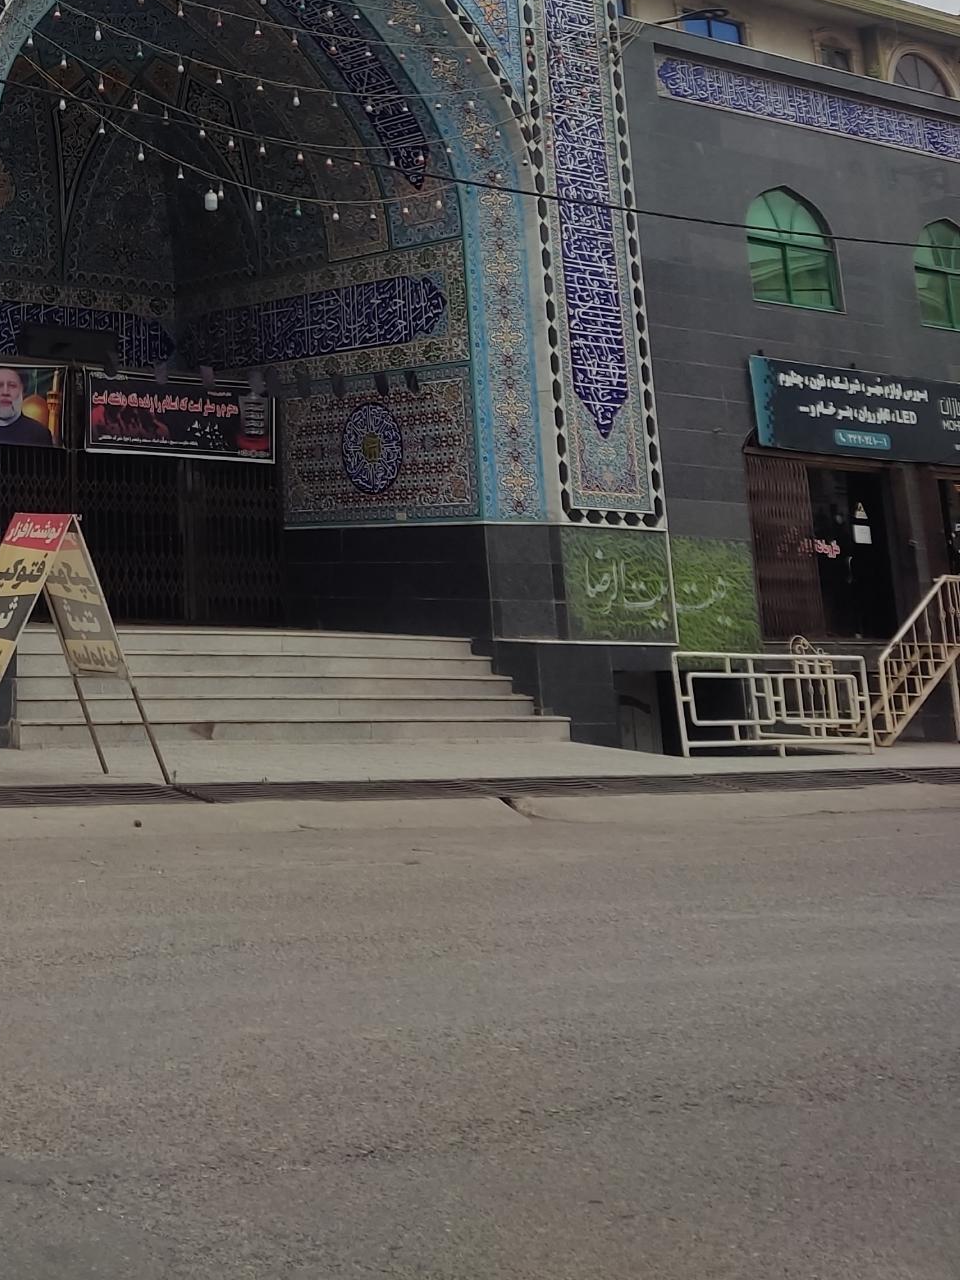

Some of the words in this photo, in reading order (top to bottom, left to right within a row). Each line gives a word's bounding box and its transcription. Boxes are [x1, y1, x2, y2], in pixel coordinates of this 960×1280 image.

[4, 517, 32, 543] افزار
[30, 520, 64, 544] نوشت
[585, 548, 627, 616] الرضا
